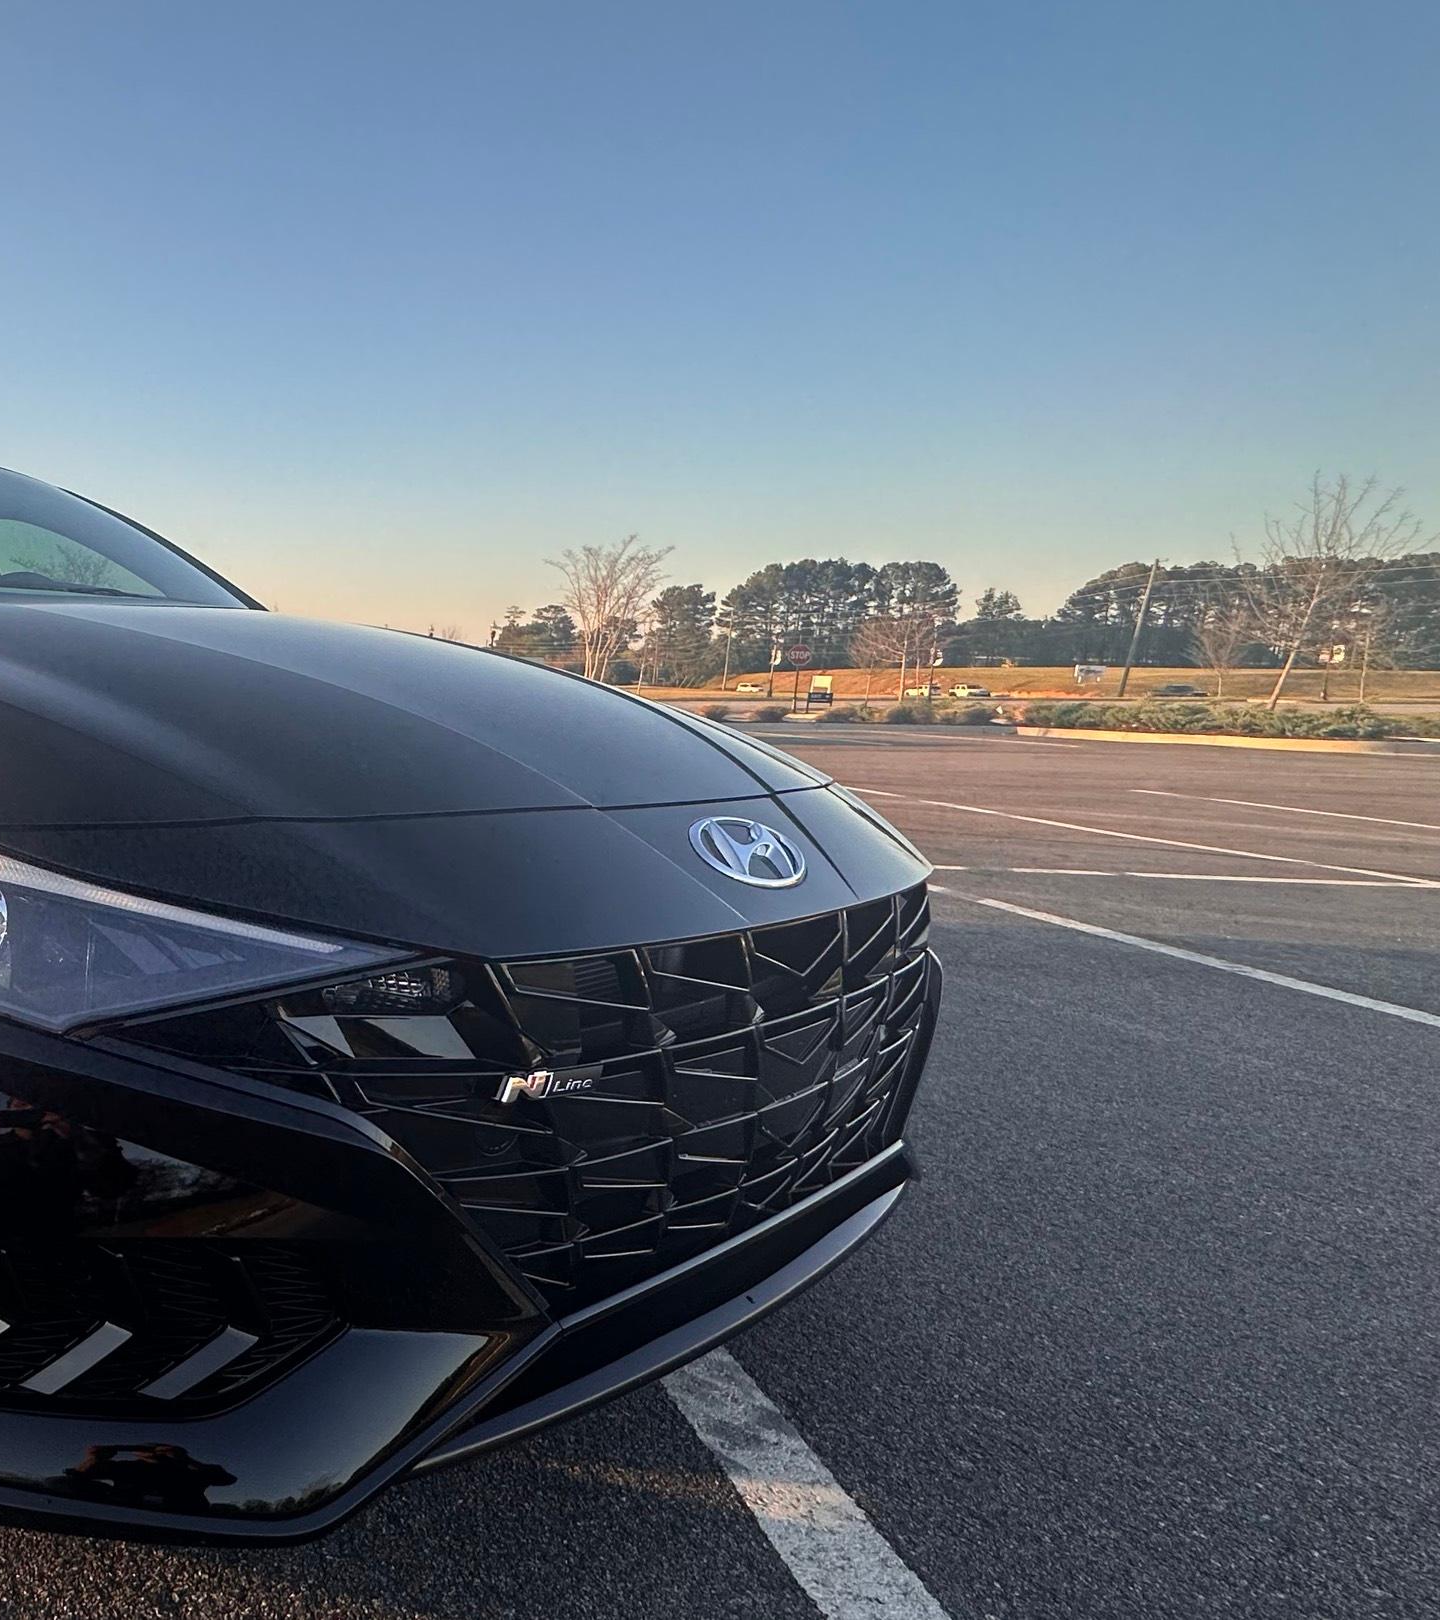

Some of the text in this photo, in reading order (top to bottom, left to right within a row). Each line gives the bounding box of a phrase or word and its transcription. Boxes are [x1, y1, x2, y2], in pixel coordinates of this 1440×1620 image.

[790, 650, 811, 660] STOP
[495, 1070, 593, 1102] N Line
